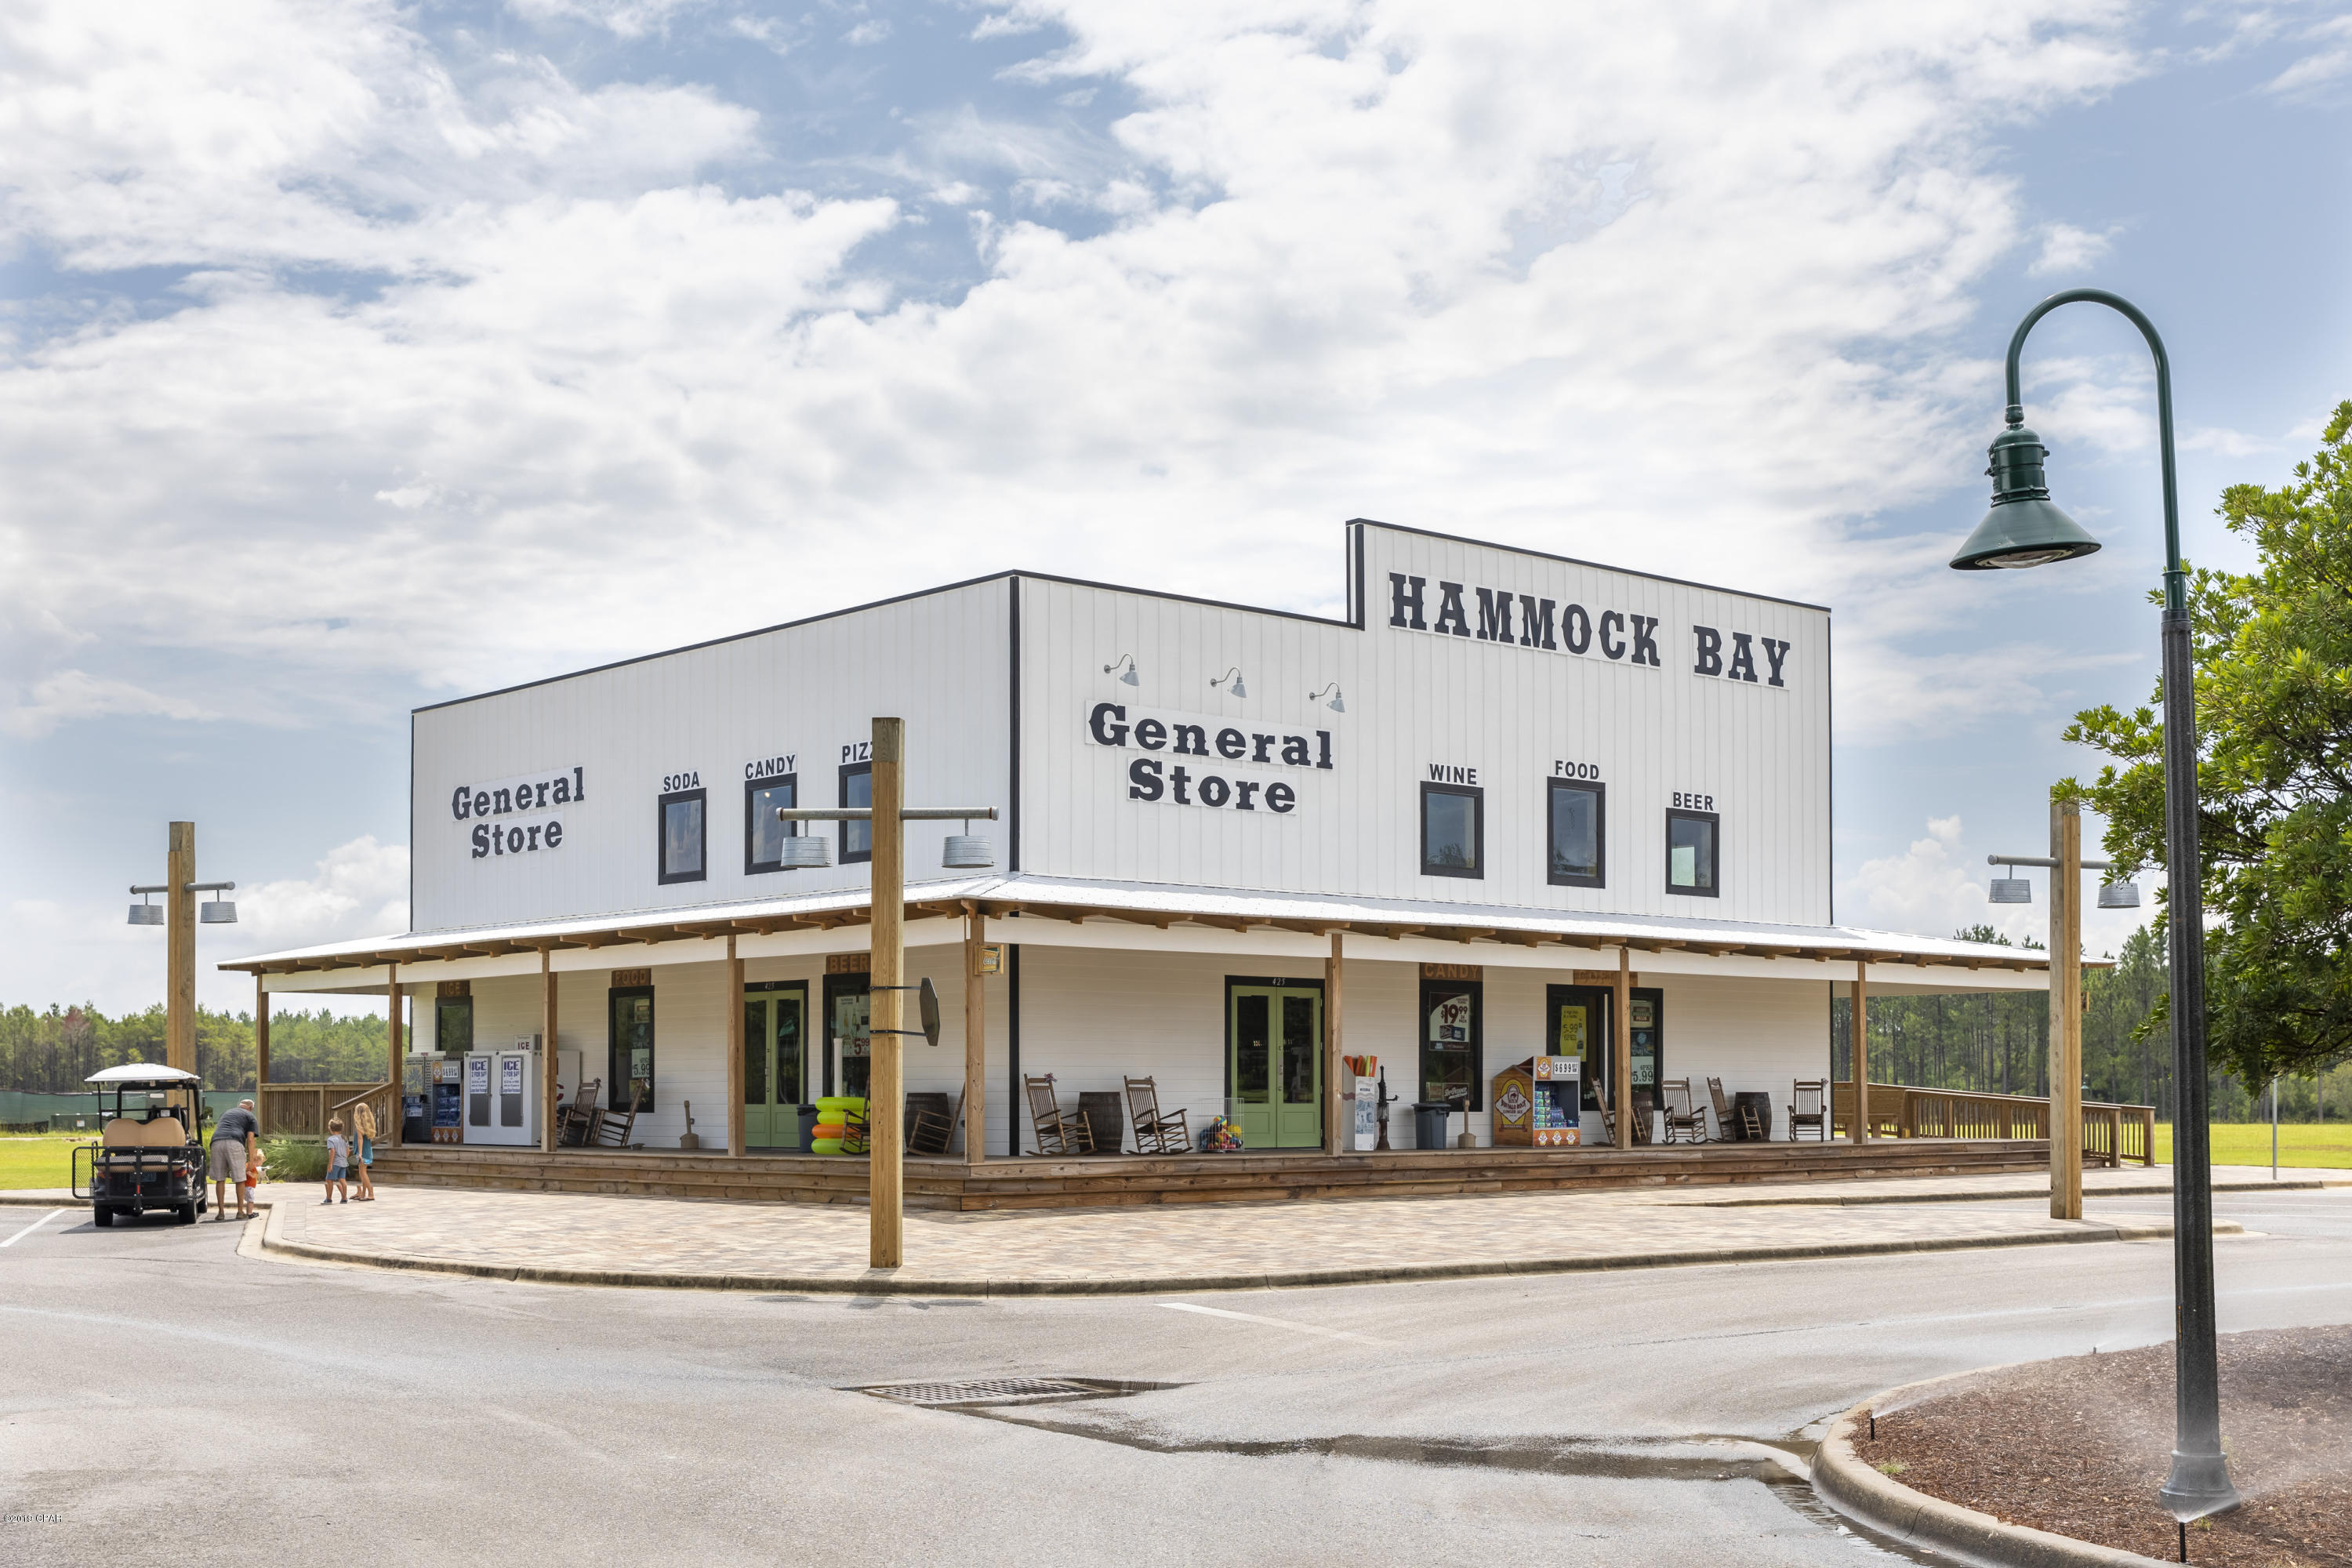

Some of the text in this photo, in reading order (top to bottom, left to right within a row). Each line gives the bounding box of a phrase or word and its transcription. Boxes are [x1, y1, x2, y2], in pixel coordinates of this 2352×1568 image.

[1389, 572, 1791, 688] HAMMOCK BAY
[1088, 702, 1333, 770] General
[842, 741, 873, 763] PIZ
[745, 754, 796, 780] CANDY
[1429, 763, 1477, 785] WINE
[1555, 760, 1599, 780] FOOD
[663, 771, 700, 792] SODA
[1129, 758, 1296, 813] Store
[452, 767, 584, 820] General
[1672, 791, 1715, 811] BEER
[472, 822, 563, 858] Store
[829, 955, 868, 972] BEER
[1424, 963, 1479, 979] CANDY
[615, 970, 647, 985] FOOD
[517, 1041, 530, 1050] ICE
[471, 1060, 487, 1071] ICE
[503, 1060, 520, 1071] ICE
